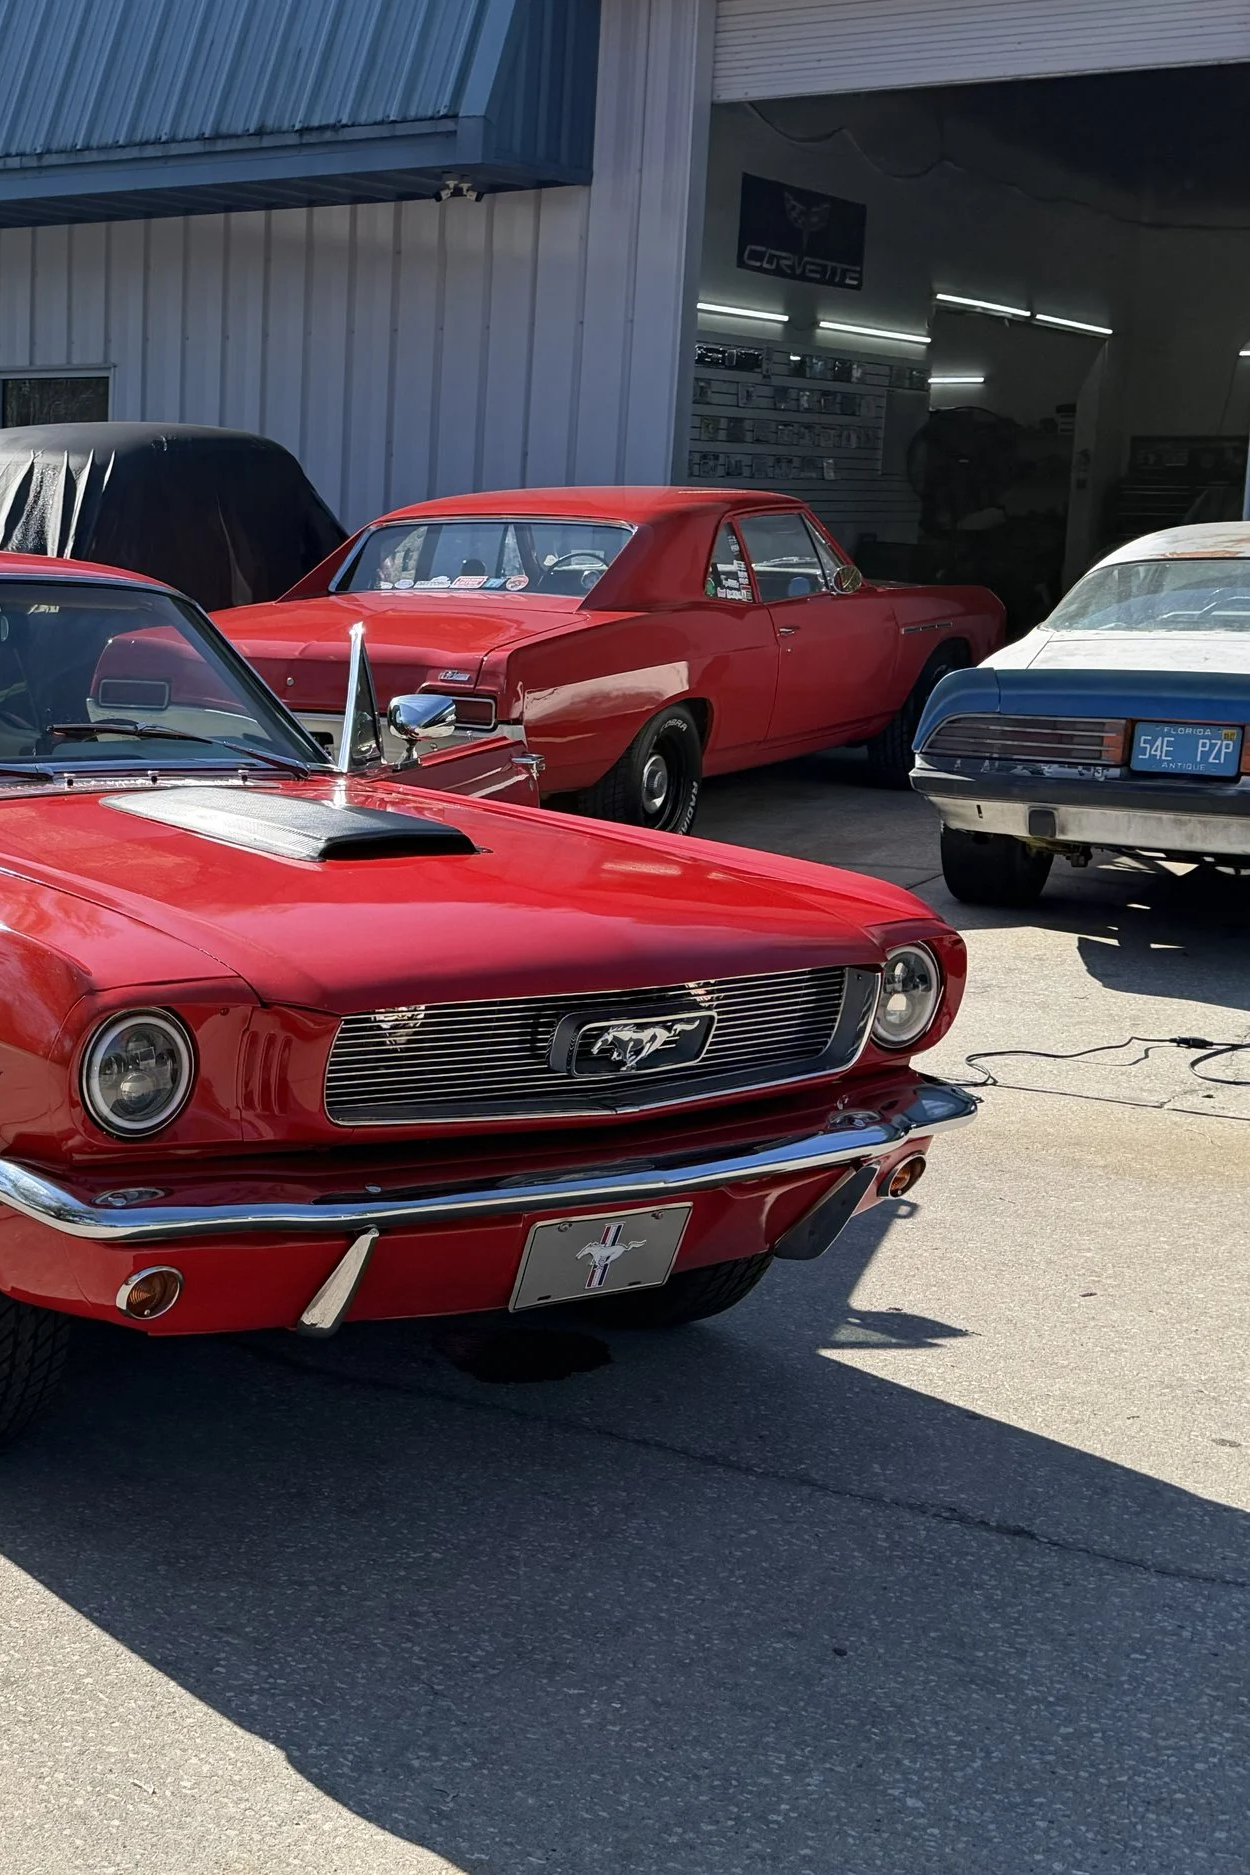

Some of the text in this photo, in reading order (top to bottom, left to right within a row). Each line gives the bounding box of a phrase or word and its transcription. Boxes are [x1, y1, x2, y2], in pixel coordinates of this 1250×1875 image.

[744, 245, 861, 286] CORVETTE
[1164, 726, 1212, 736] FLORIDA
[1138, 735, 1234, 763] 54E PZP
[1161, 761, 1207, 771] ANTIQUE
